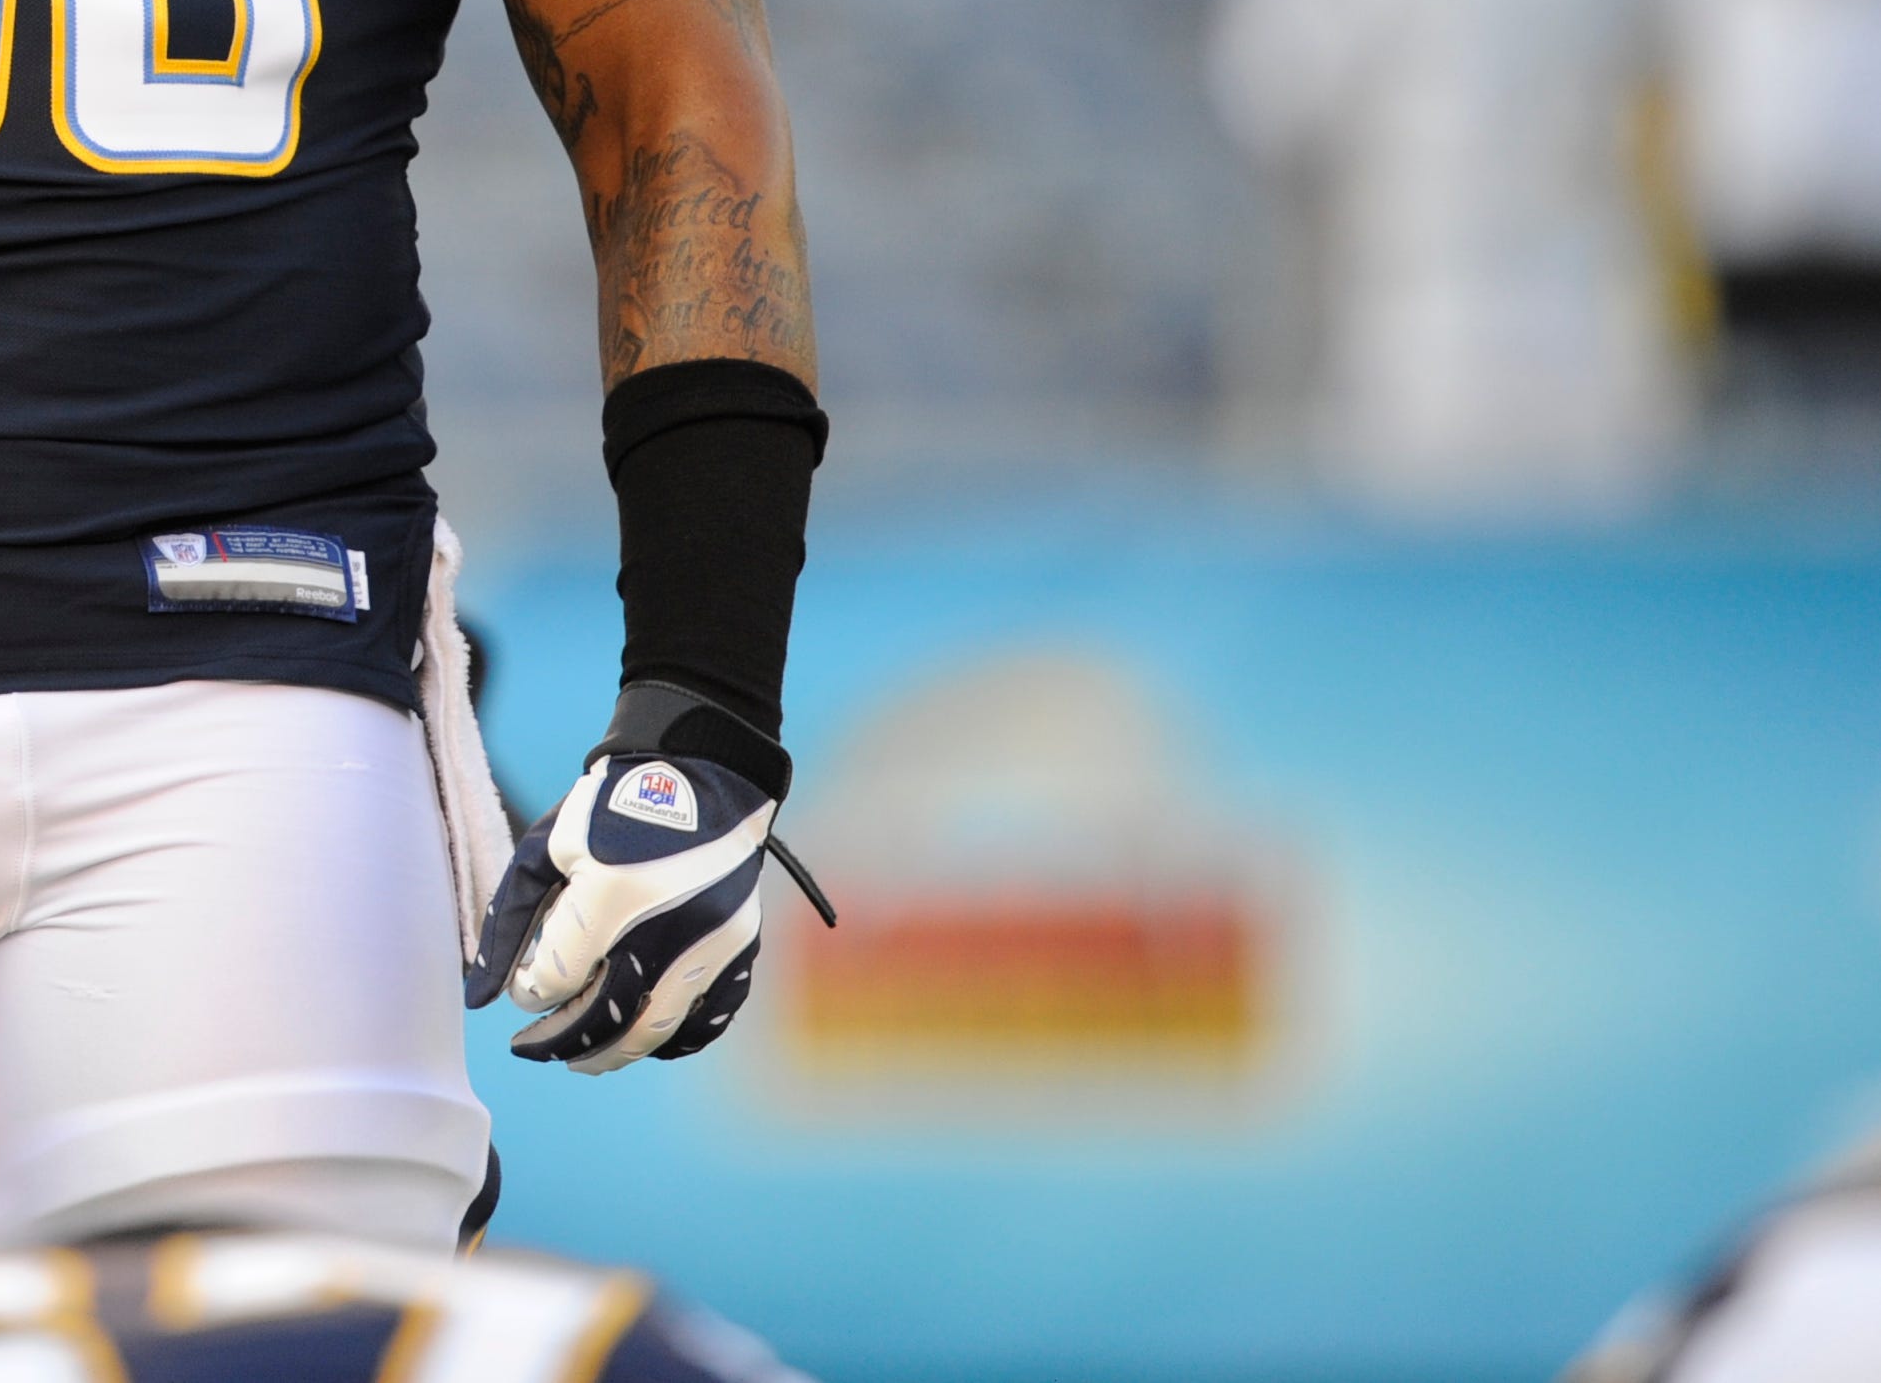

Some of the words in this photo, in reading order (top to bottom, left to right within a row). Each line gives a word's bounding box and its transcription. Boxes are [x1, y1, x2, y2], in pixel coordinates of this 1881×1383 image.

[295, 587, 340, 604] Reebok
[643, 775, 674, 795] NFL
[623, 798, 688, 821] EQUIPMENT
